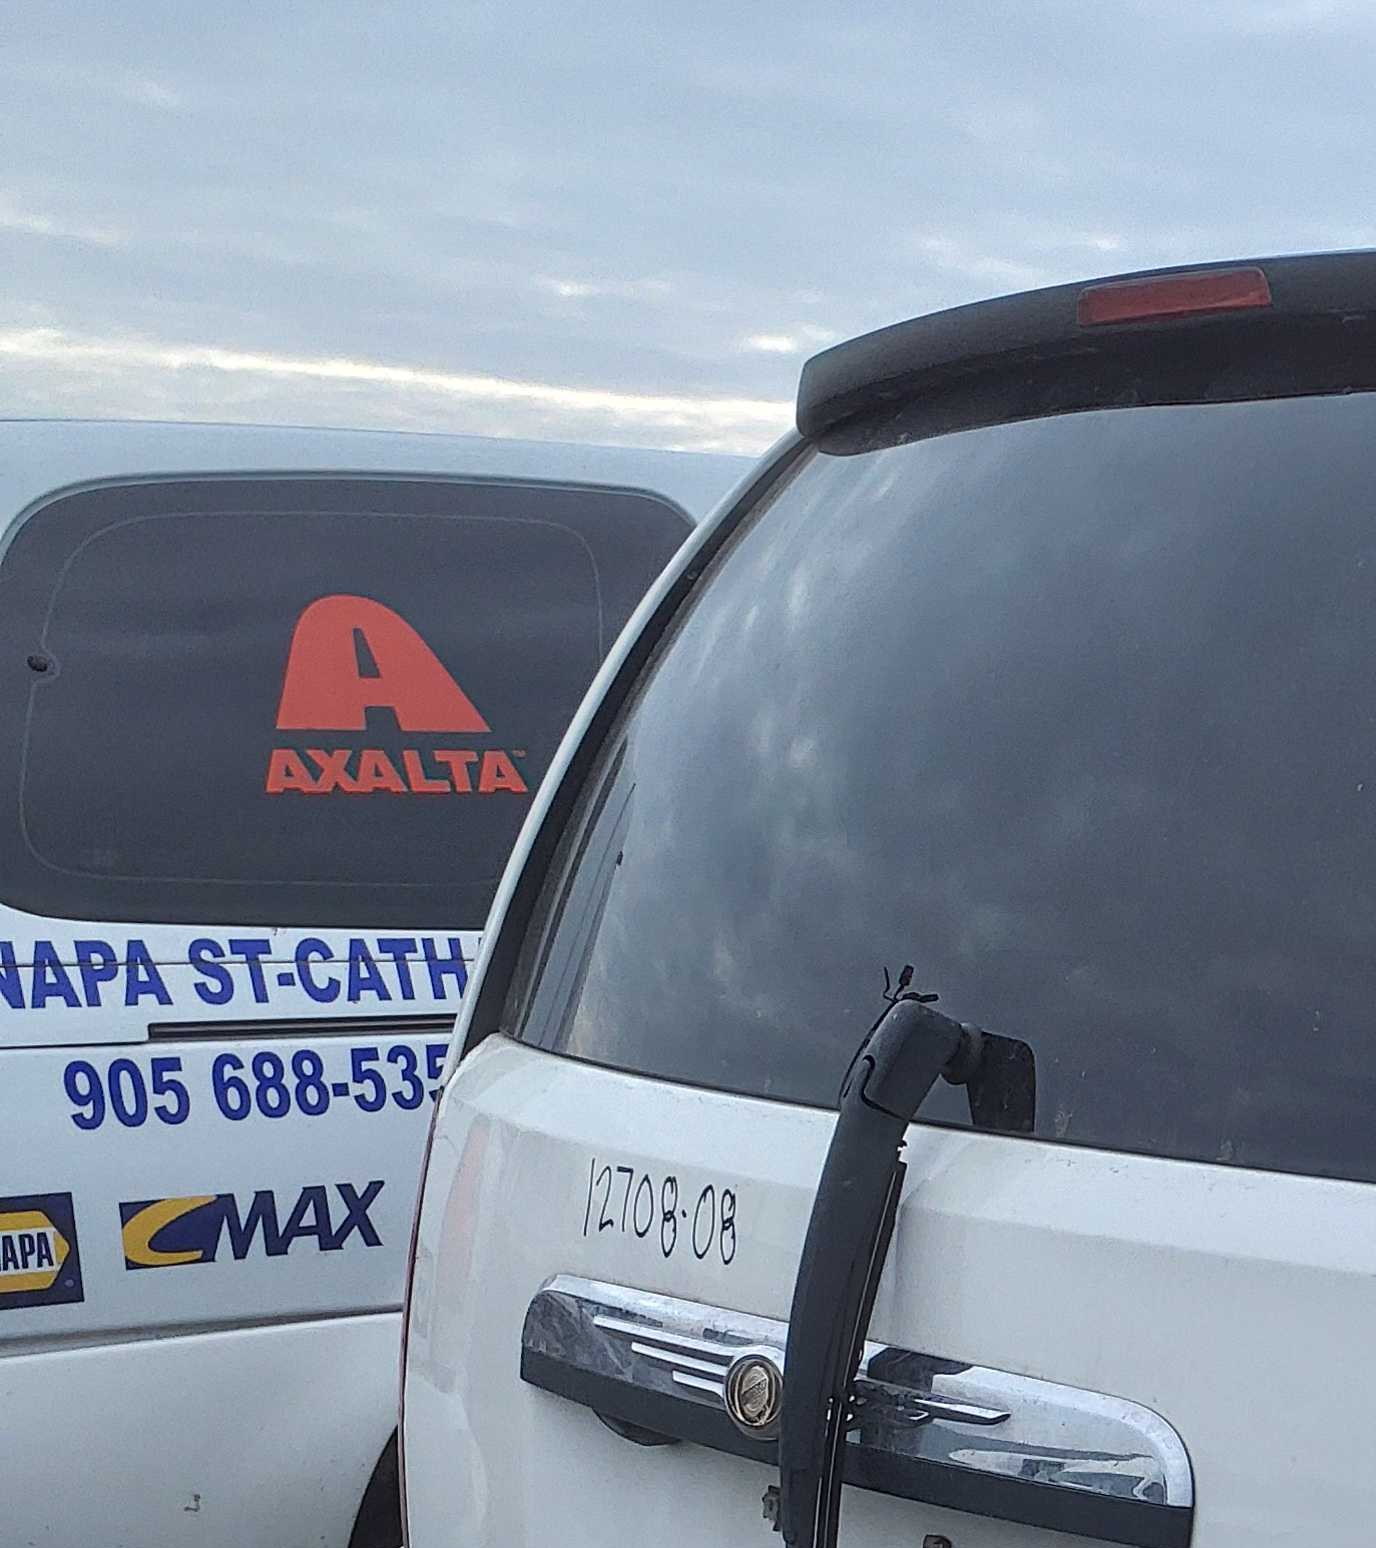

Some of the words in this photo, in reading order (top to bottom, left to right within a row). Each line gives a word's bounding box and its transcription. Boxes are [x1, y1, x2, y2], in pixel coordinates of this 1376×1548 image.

[266, 749, 528, 793] AXALTA
[188, 937, 481, 1004] ST-CATH
[63, 1057, 190, 1130] 905
[0, 1231, 54, 1273] APA
